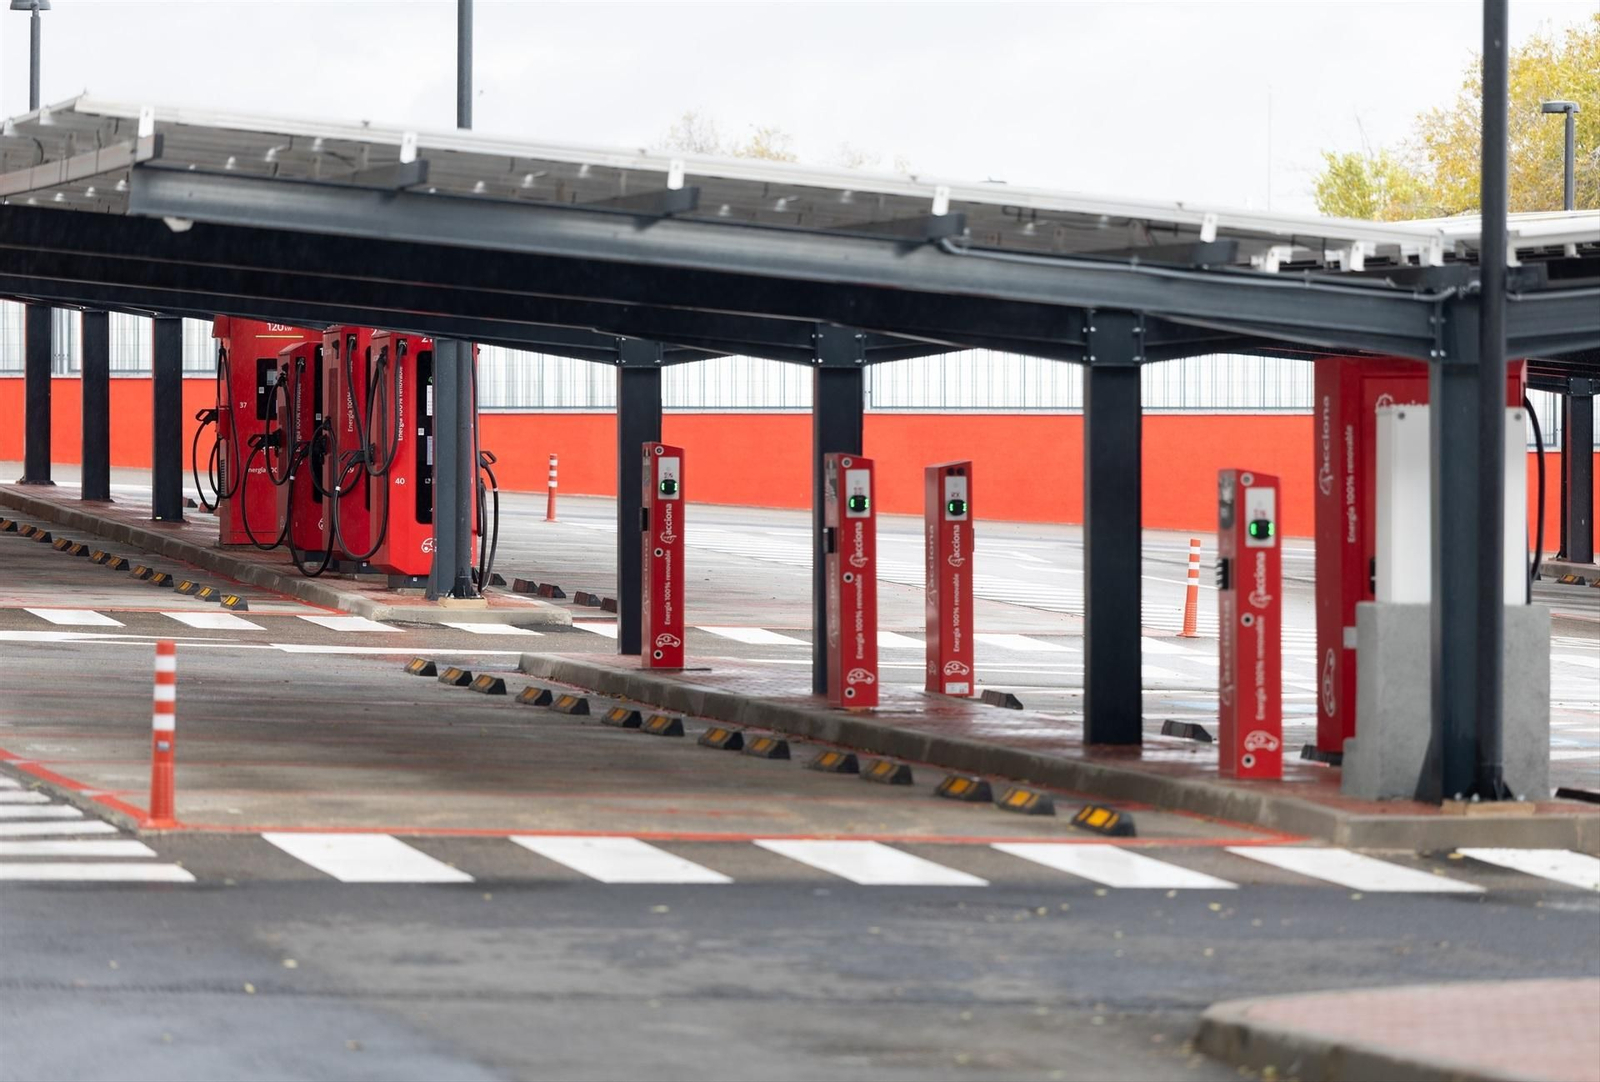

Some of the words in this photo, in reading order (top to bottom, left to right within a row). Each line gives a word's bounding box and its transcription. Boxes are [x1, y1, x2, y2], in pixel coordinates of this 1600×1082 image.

[267, 322, 285, 332] 120
[240, 401, 248, 409] 37
[1345, 425, 1354, 474] renovable
[394, 477, 405, 485] 40
[1346, 475, 1355, 505] 100%
[952, 573, 960, 606] renovable
[855, 610, 863, 632] 100%
